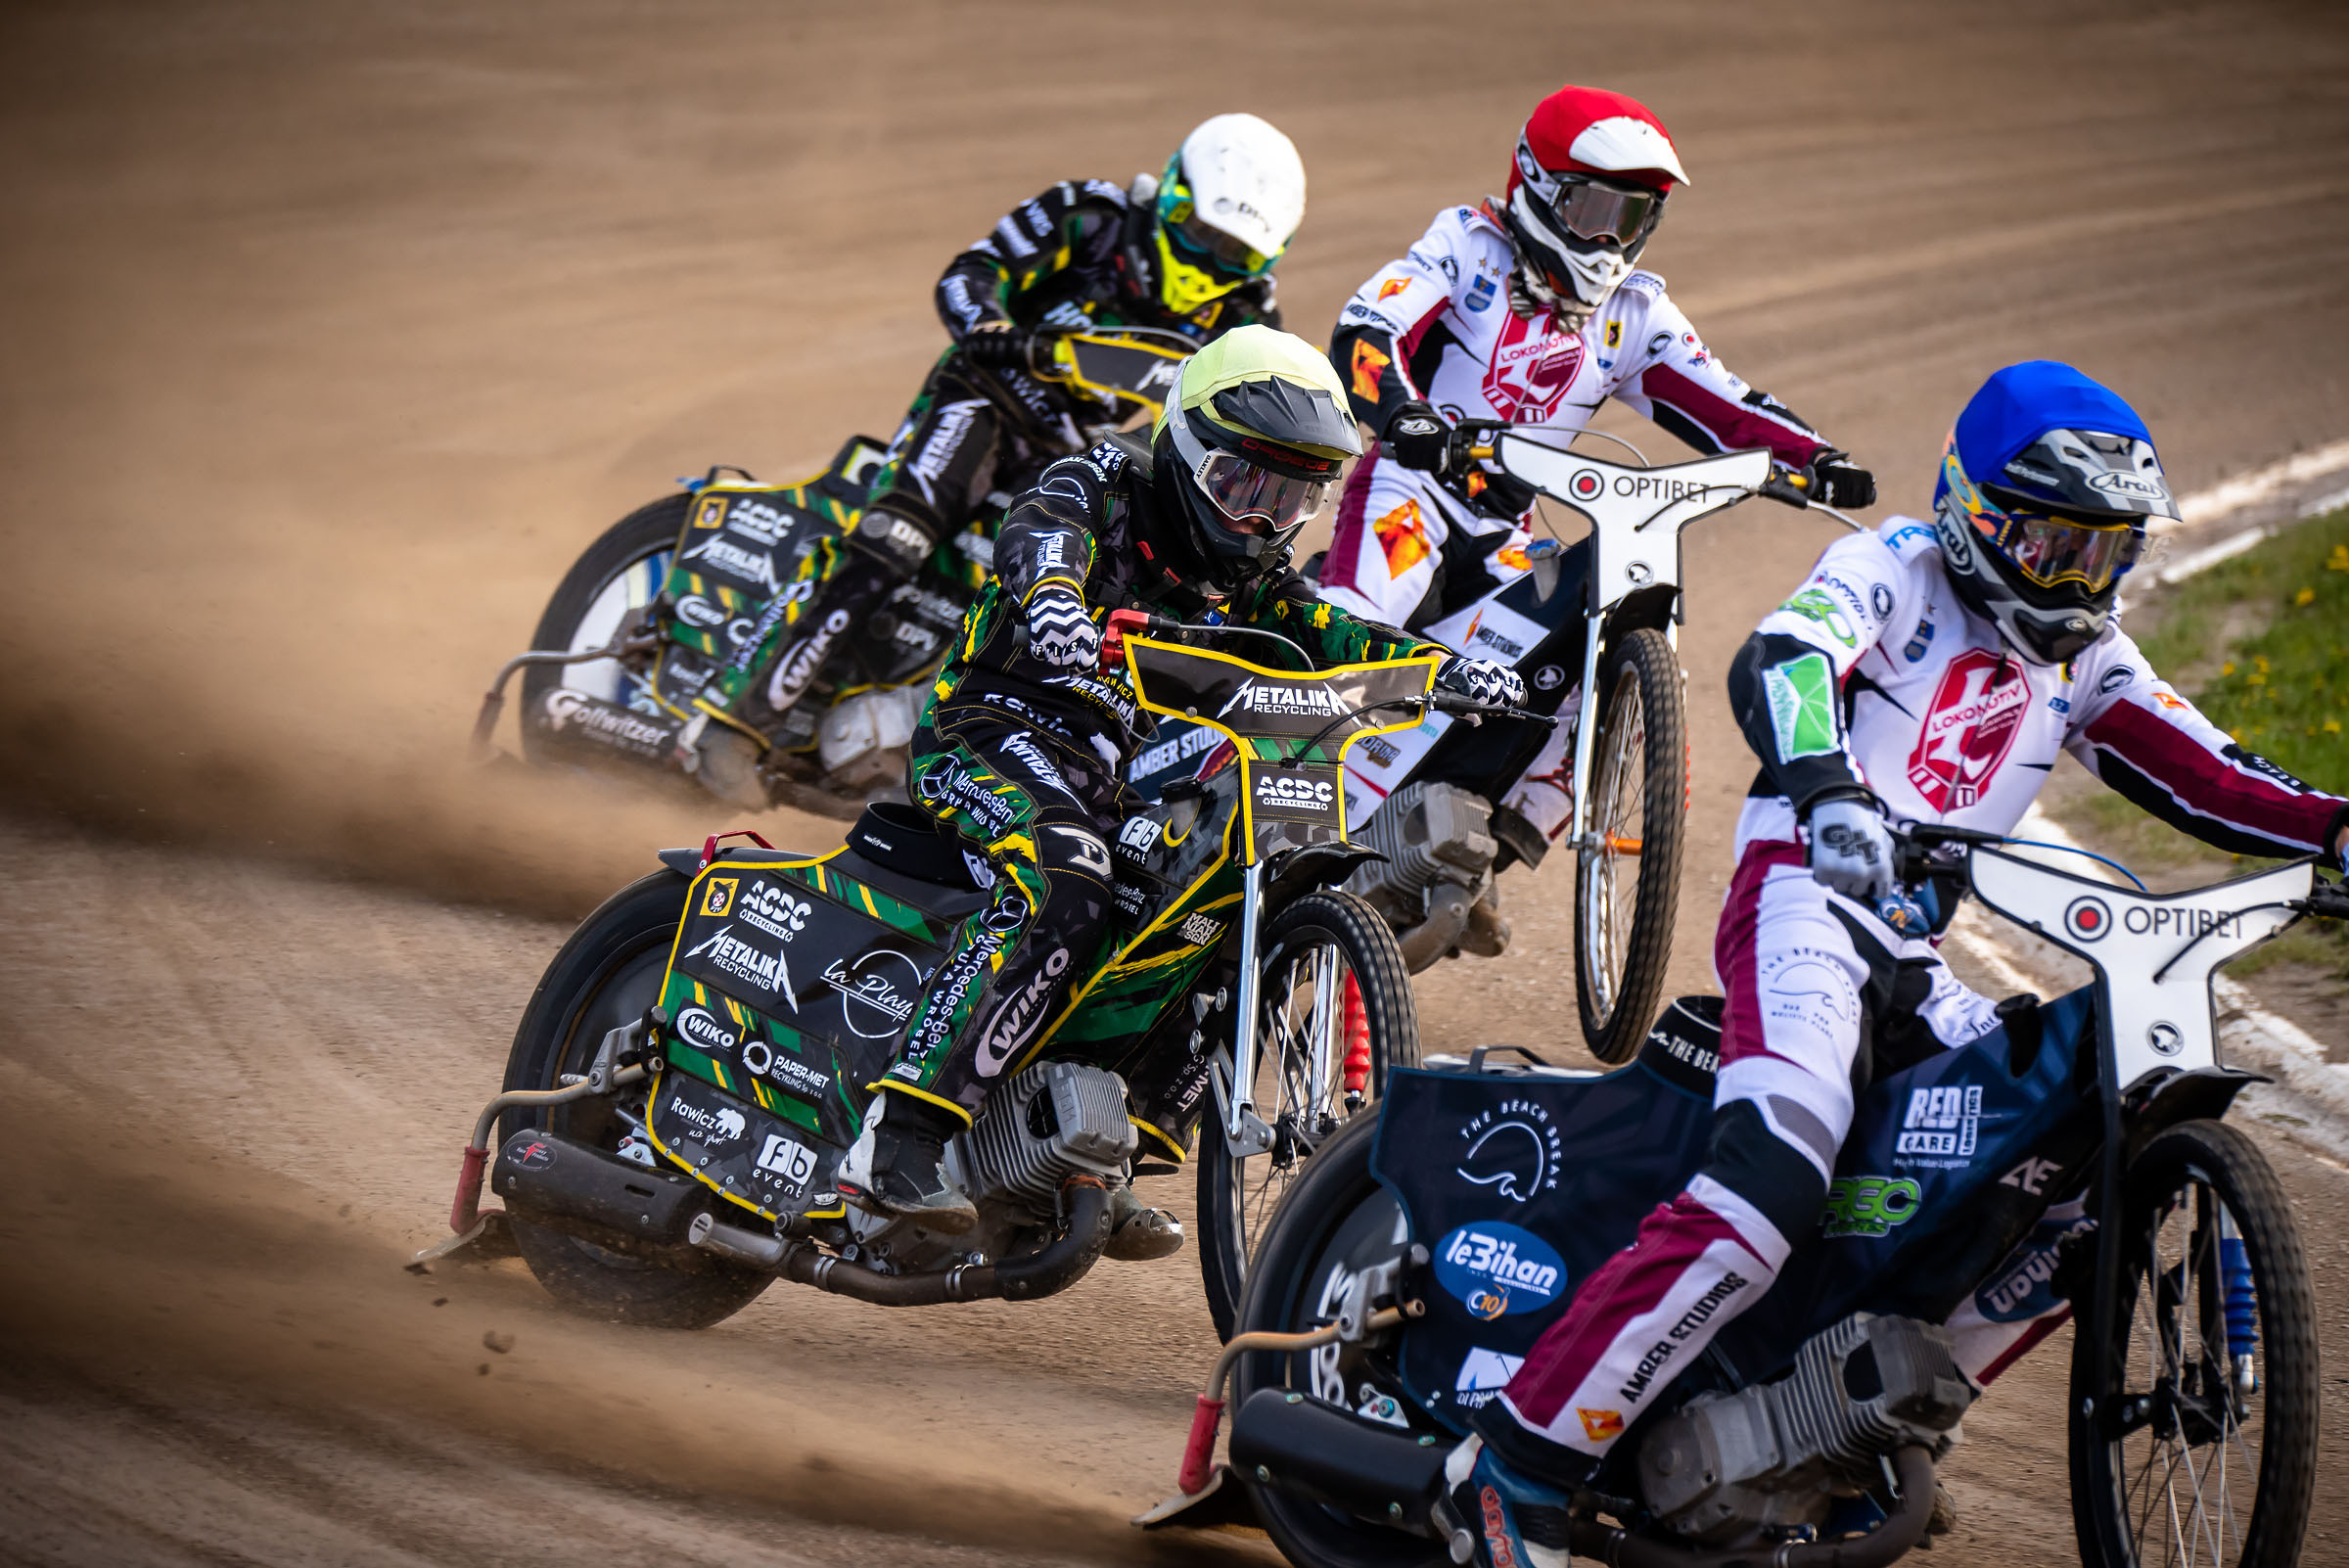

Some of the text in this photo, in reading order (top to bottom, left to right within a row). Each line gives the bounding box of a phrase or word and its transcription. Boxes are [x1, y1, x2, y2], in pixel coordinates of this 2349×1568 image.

[1197, 454, 1212, 480] OAKLEY
[1613, 476, 1711, 504] OPTIBET
[2092, 474, 2159, 496] Arai
[782, 608, 851, 689] WIKO
[1041, 675, 1137, 736] METALIKA
[1216, 676, 1363, 728] METALIKA
[1254, 704, 1332, 717] RECYCLING
[1128, 738, 1181, 784] AMBER
[1256, 775, 1334, 803] ACDC
[1273, 799, 1318, 809] RECYCLING
[1125, 819, 1154, 848] fb
[1115, 844, 1147, 864] event
[740, 879, 812, 932] ACDC
[1187, 911, 1221, 931] MALI
[2124, 905, 2241, 941] OPTIBET
[747, 913, 785, 938] RECYCLING
[683, 923, 799, 1015] METALIKA
[713, 954, 772, 992] RECYCLING
[991, 947, 1071, 1050] WIKO
[686, 1015, 735, 1048] WIKO
[1667, 1034, 1721, 1074] THE BEA
[770, 1068, 802, 1090] RECYKLING
[670, 1096, 718, 1130] Rawicz
[1903, 1085, 1962, 1130] RED
[767, 1139, 808, 1179] fb
[1460, 1098, 1562, 1189] THE BEACH BREAK
[1904, 1135, 1953, 1152] CARE
[752, 1168, 804, 1199] event
[1619, 1270, 1750, 1405] AMBER STUDIOS
[1480, 1485, 1519, 1568] dayto
